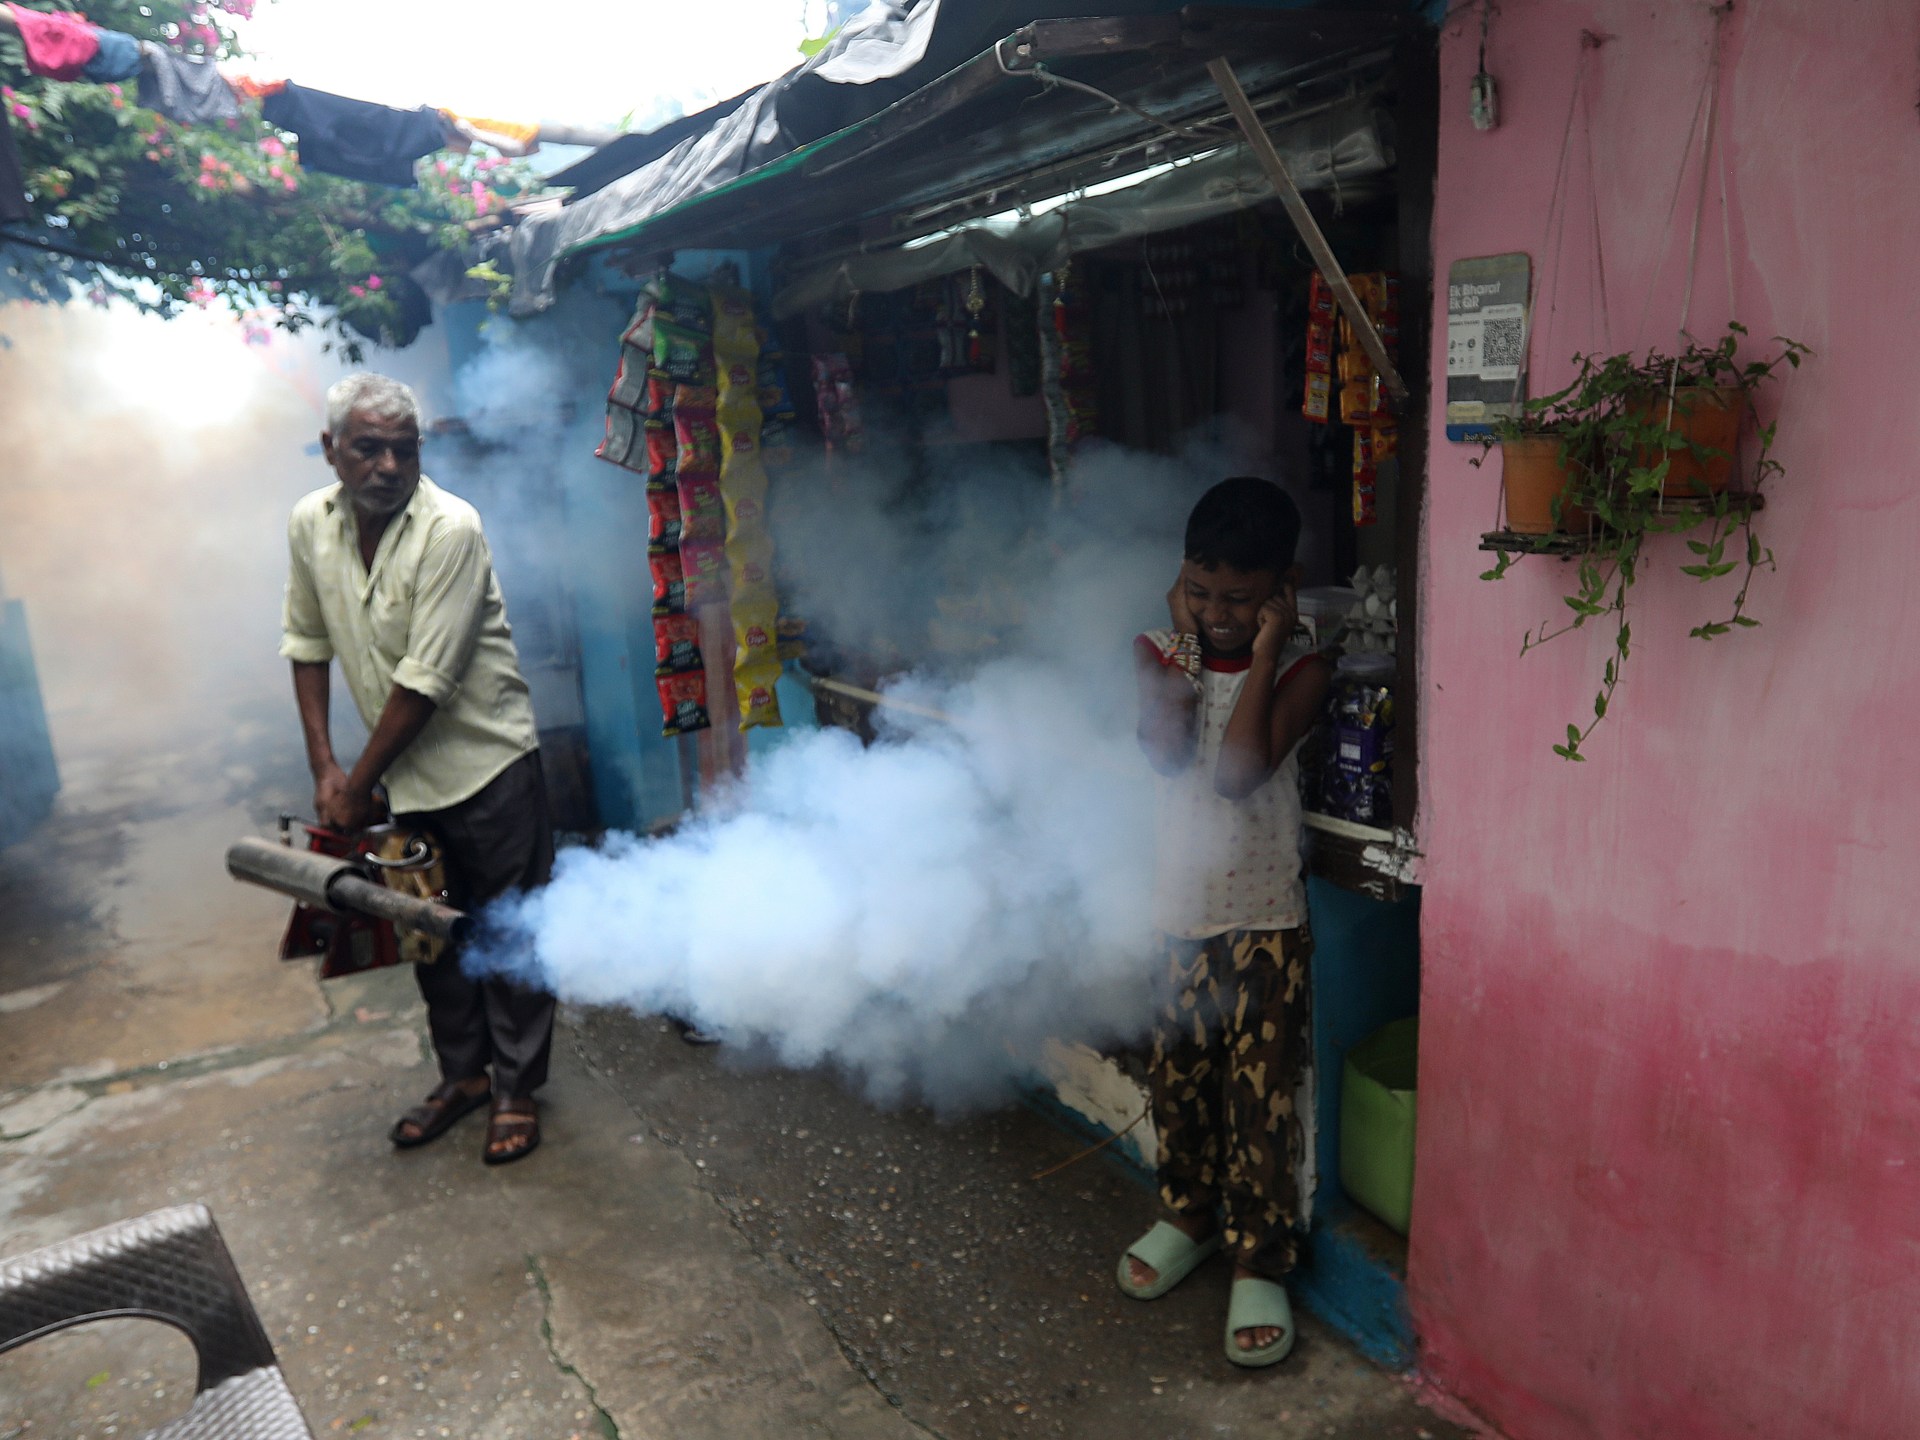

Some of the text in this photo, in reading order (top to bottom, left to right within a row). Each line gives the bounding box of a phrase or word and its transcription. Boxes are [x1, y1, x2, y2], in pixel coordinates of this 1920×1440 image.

[1449, 281, 1501, 297] Ek Bharat
[1449, 296, 1479, 309] Ek QR
